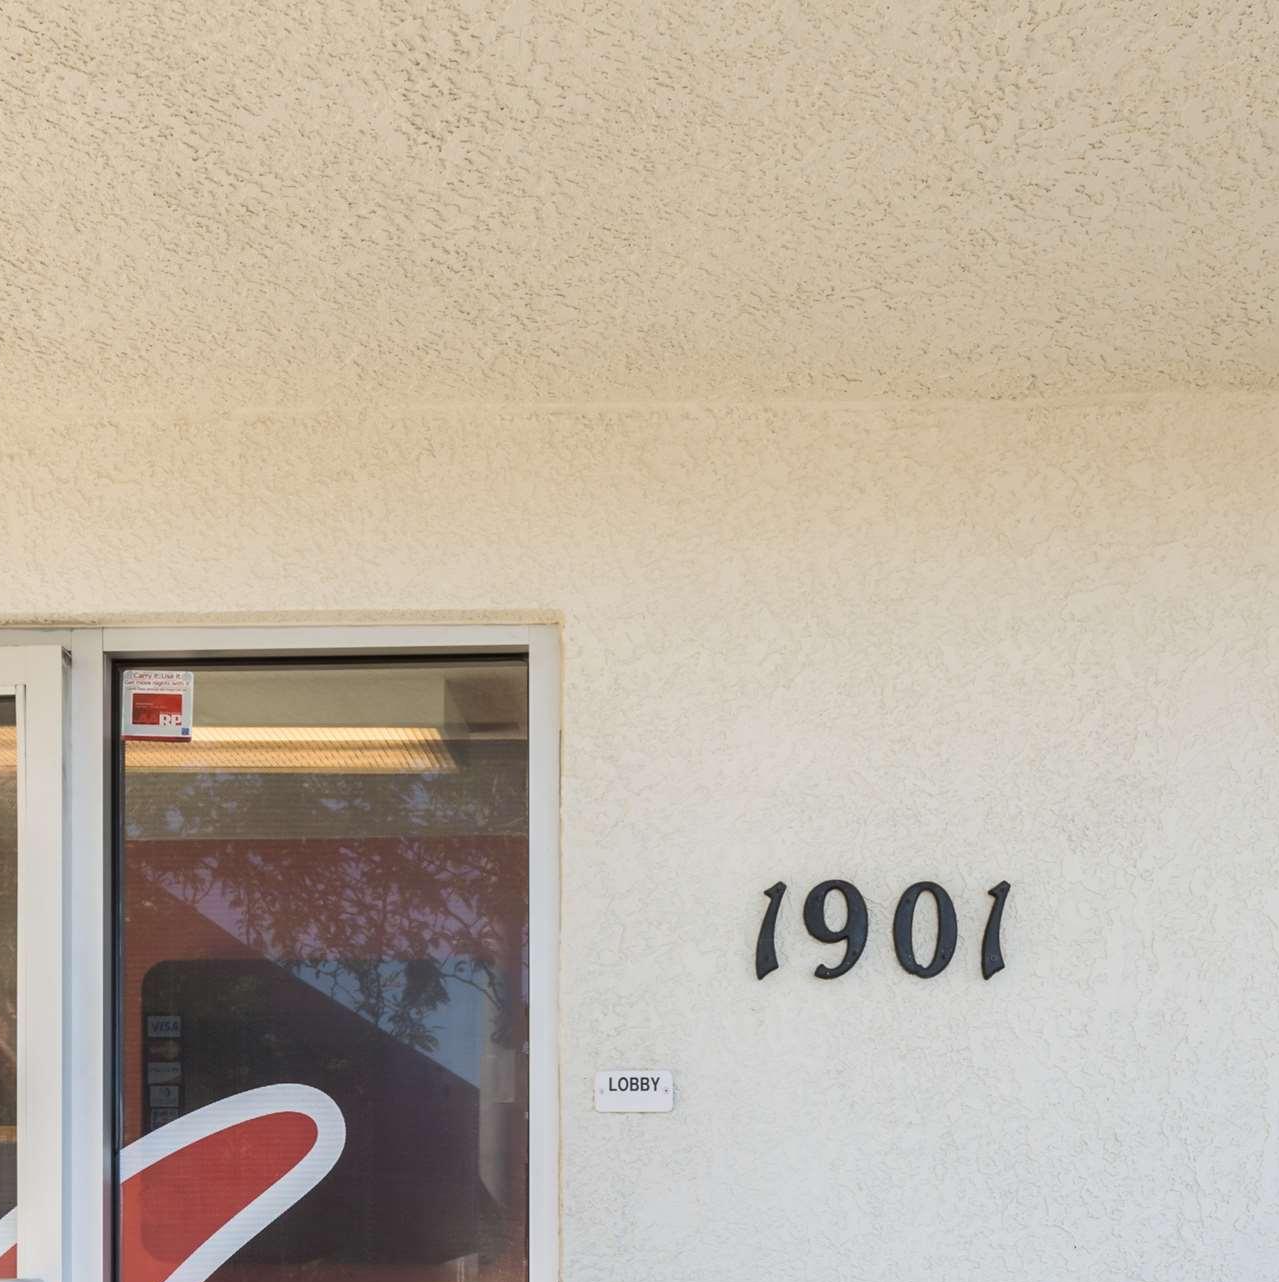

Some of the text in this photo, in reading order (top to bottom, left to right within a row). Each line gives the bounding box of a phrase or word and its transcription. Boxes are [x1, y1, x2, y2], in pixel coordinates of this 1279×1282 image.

[756, 879, 1011, 980] 1901
[151, 1022, 178, 1032] VISA
[608, 1076, 661, 1092] LOBBY
